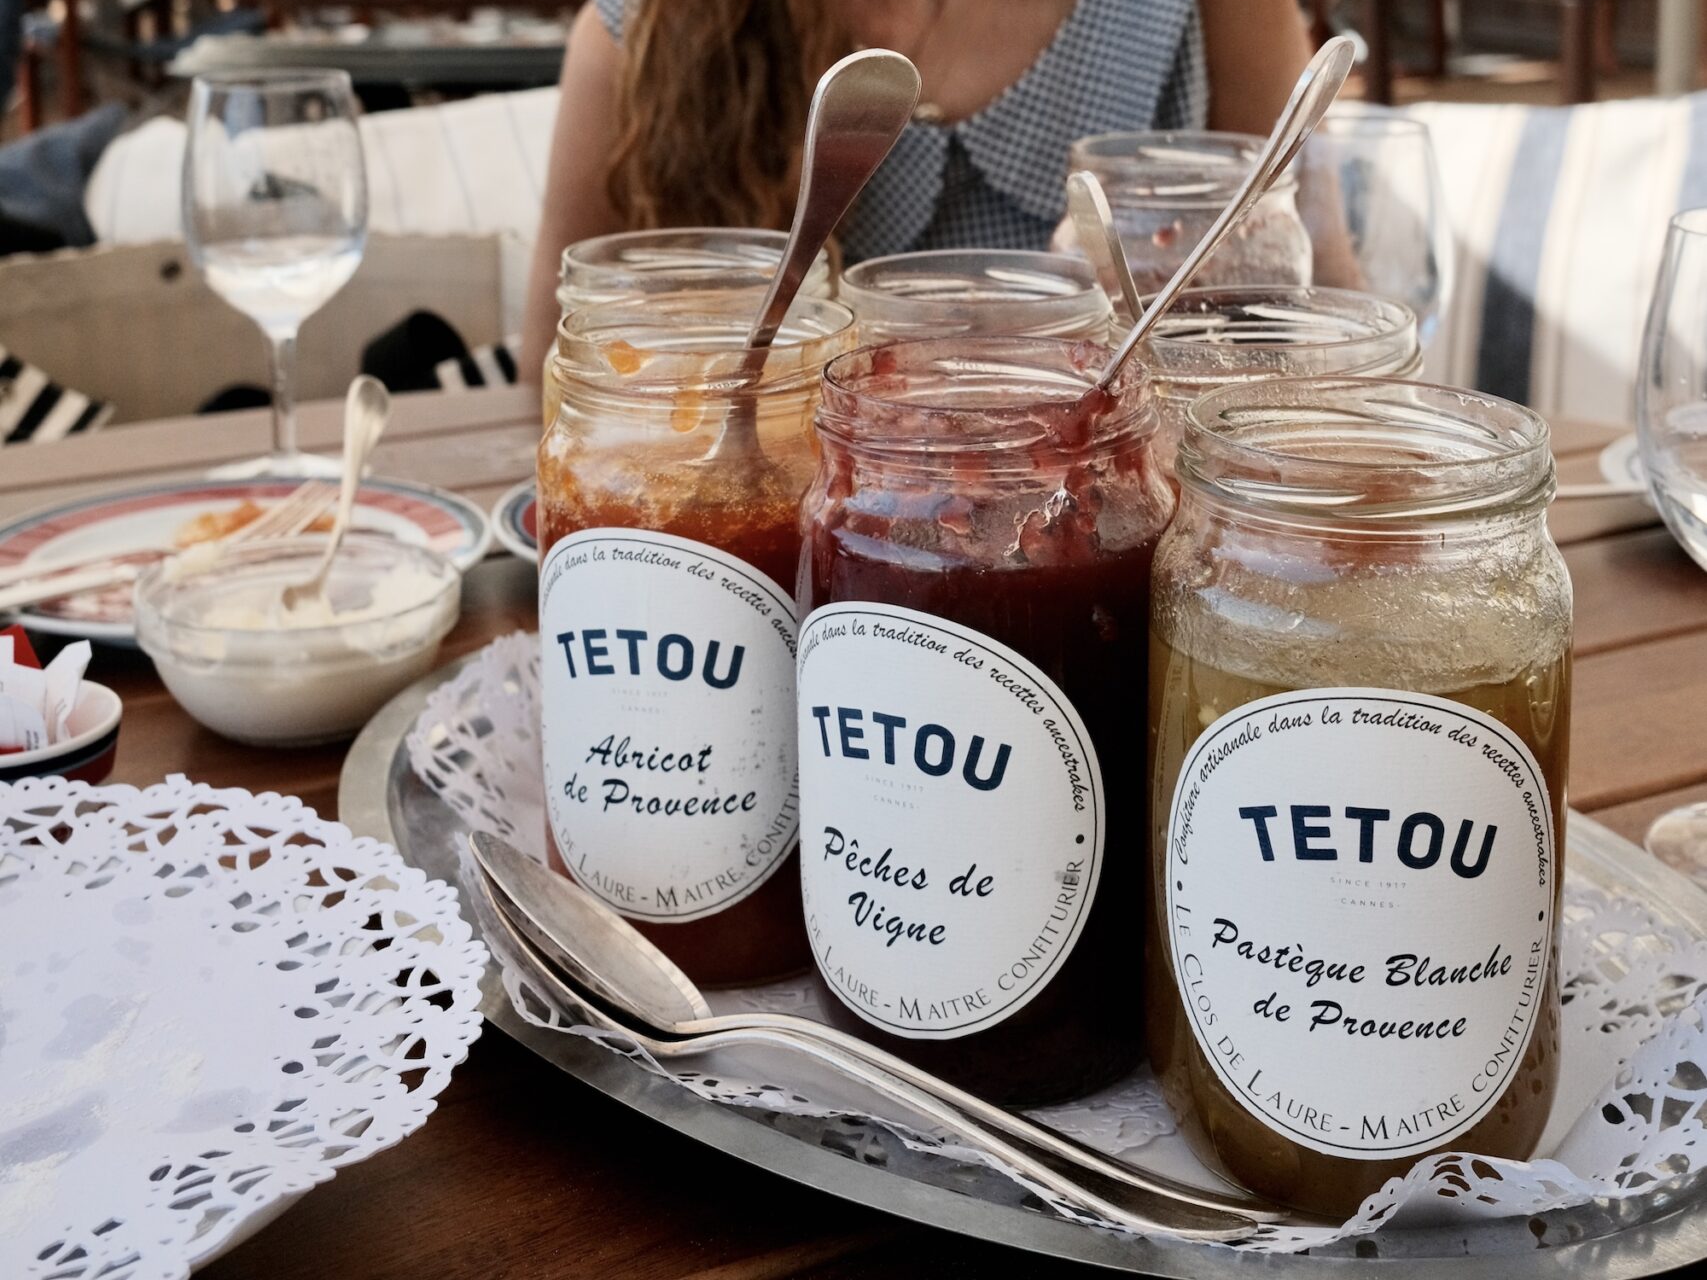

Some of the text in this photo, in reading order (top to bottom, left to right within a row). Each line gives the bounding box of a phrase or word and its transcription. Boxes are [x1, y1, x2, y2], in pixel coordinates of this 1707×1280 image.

[565, 551, 588, 570] dans
[592, 546, 606, 562] la
[612, 547, 681, 570] tradition
[687, 561, 715, 580] des
[720, 577, 771, 616] recettes
[556, 628, 746, 690] TETOU
[822, 623, 847, 640] dans
[851, 618, 867, 636] la
[873, 621, 948, 653] tradition
[953, 647, 985, 670] des
[989, 666, 1045, 715] recettes
[585, 734, 713, 773] Abricot
[812, 705, 1013, 792] TETOU
[564, 773, 758, 817] de Provence
[864, 774, 894, 788] SINCE
[1174, 781, 1200, 866] Confiture
[1199, 722, 1262, 783] artisanale
[1268, 712, 1314, 734] dans
[1321, 705, 1344, 725] la
[1351, 708, 1443, 735] tradition
[1448, 726, 1478, 749] des
[1481, 743, 1525, 788] recettes
[823, 825, 931, 891] Pêches
[949, 863, 995, 898] de
[1238, 804, 1499, 879] TETOU
[579, 853, 635, 902] LAURE
[656, 867, 740, 908] MAITRE
[1330, 877, 1407, 889] SINCE 1917
[824, 945, 879, 1008] LAURE
[899, 987, 991, 1021] MAITRE
[998, 859, 1085, 991] CONFITURIER
[847, 891, 947, 948] Vigne
[1176, 904, 1191, 937] LE
[1212, 918, 1514, 989] Pastèque Blanche
[1183, 952, 1218, 1027] CLOS
[1253, 992, 1468, 1041] de Provence
[1472, 941, 1544, 1094] CONFITURIER
[1217, 1034, 1245, 1071] DE
[1247, 1070, 1333, 1132] LAURE
[1361, 1094, 1465, 1140] MAITRE
